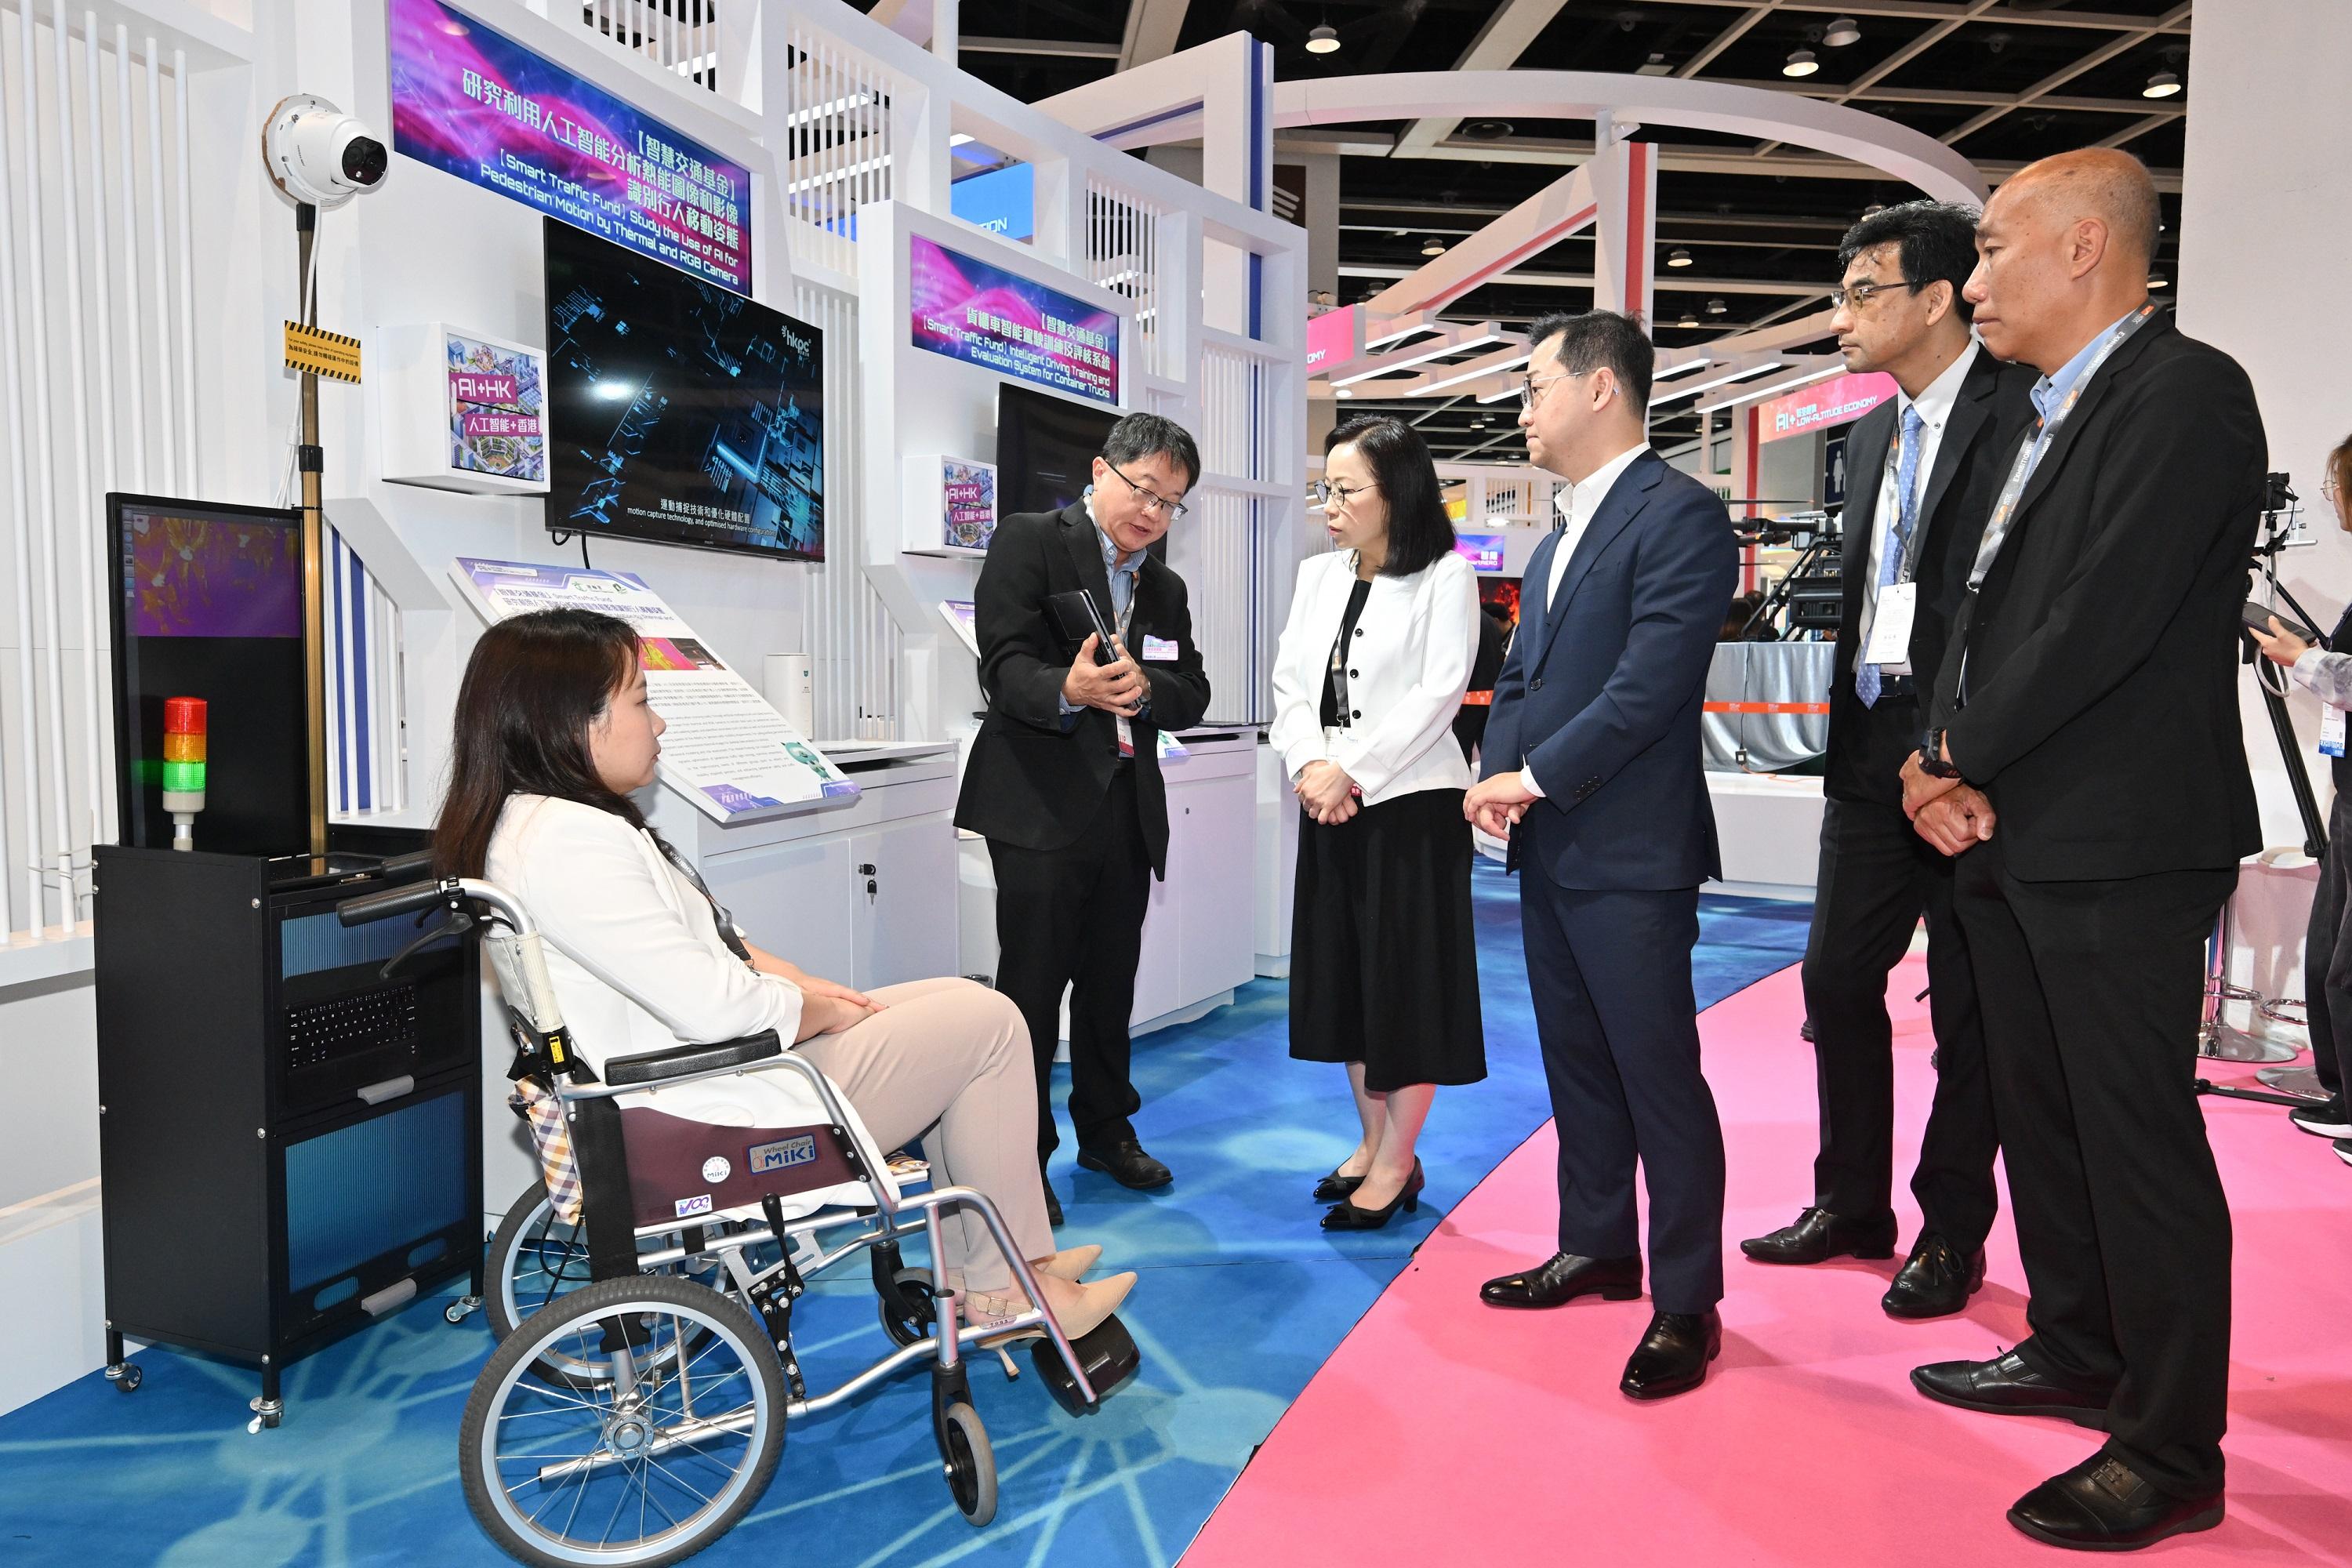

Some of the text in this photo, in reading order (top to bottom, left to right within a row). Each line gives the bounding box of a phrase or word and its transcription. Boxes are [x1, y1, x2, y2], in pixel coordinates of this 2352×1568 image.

[463, 67, 739, 227] 研究利用人工智能分析熱能圖像和影像
[638, 130, 735, 201] 【智慧交通基金】
[481, 162, 739, 286] Pedestrian Motion by Thermal and RGB Camera
[549, 172, 590, 203] Traffic
[630, 210, 661, 237] Study
[662, 225, 680, 243] the
[681, 234, 701, 251] Use
[702, 244, 712, 257] of
[713, 248, 724, 261] AI
[724, 252, 739, 268] for
[627, 177, 739, 251] 識別行人移動姿態
[786, 329, 809, 353] hkpc
[1042, 313, 1109, 352] 【智慧交通基金】
[955, 327, 983, 346] Traffic
[1010, 345, 1045, 366] Intelligent
[1046, 357, 1070, 376] Driving
[1071, 365, 1098, 385] Training
[1098, 376, 1110, 387] and
[971, 346, 1110, 398] Evaluation System for Container Trucks
[458, 378, 512, 398] AI+HK
[469, 417, 537, 433] 人工智能+香港
[1796, 395, 1878, 427] LOW-ALTITUDE ECONOMY
[949, 487, 978, 499] AI+HK
[627, 507, 646, 517] motion
[647, 510, 666, 520] capture
[666, 513, 695, 525] technology,
[704, 520, 727, 529] optimised
[727, 522, 748, 532] hardware
[764, 1139, 811, 1154] Wheel Chair
